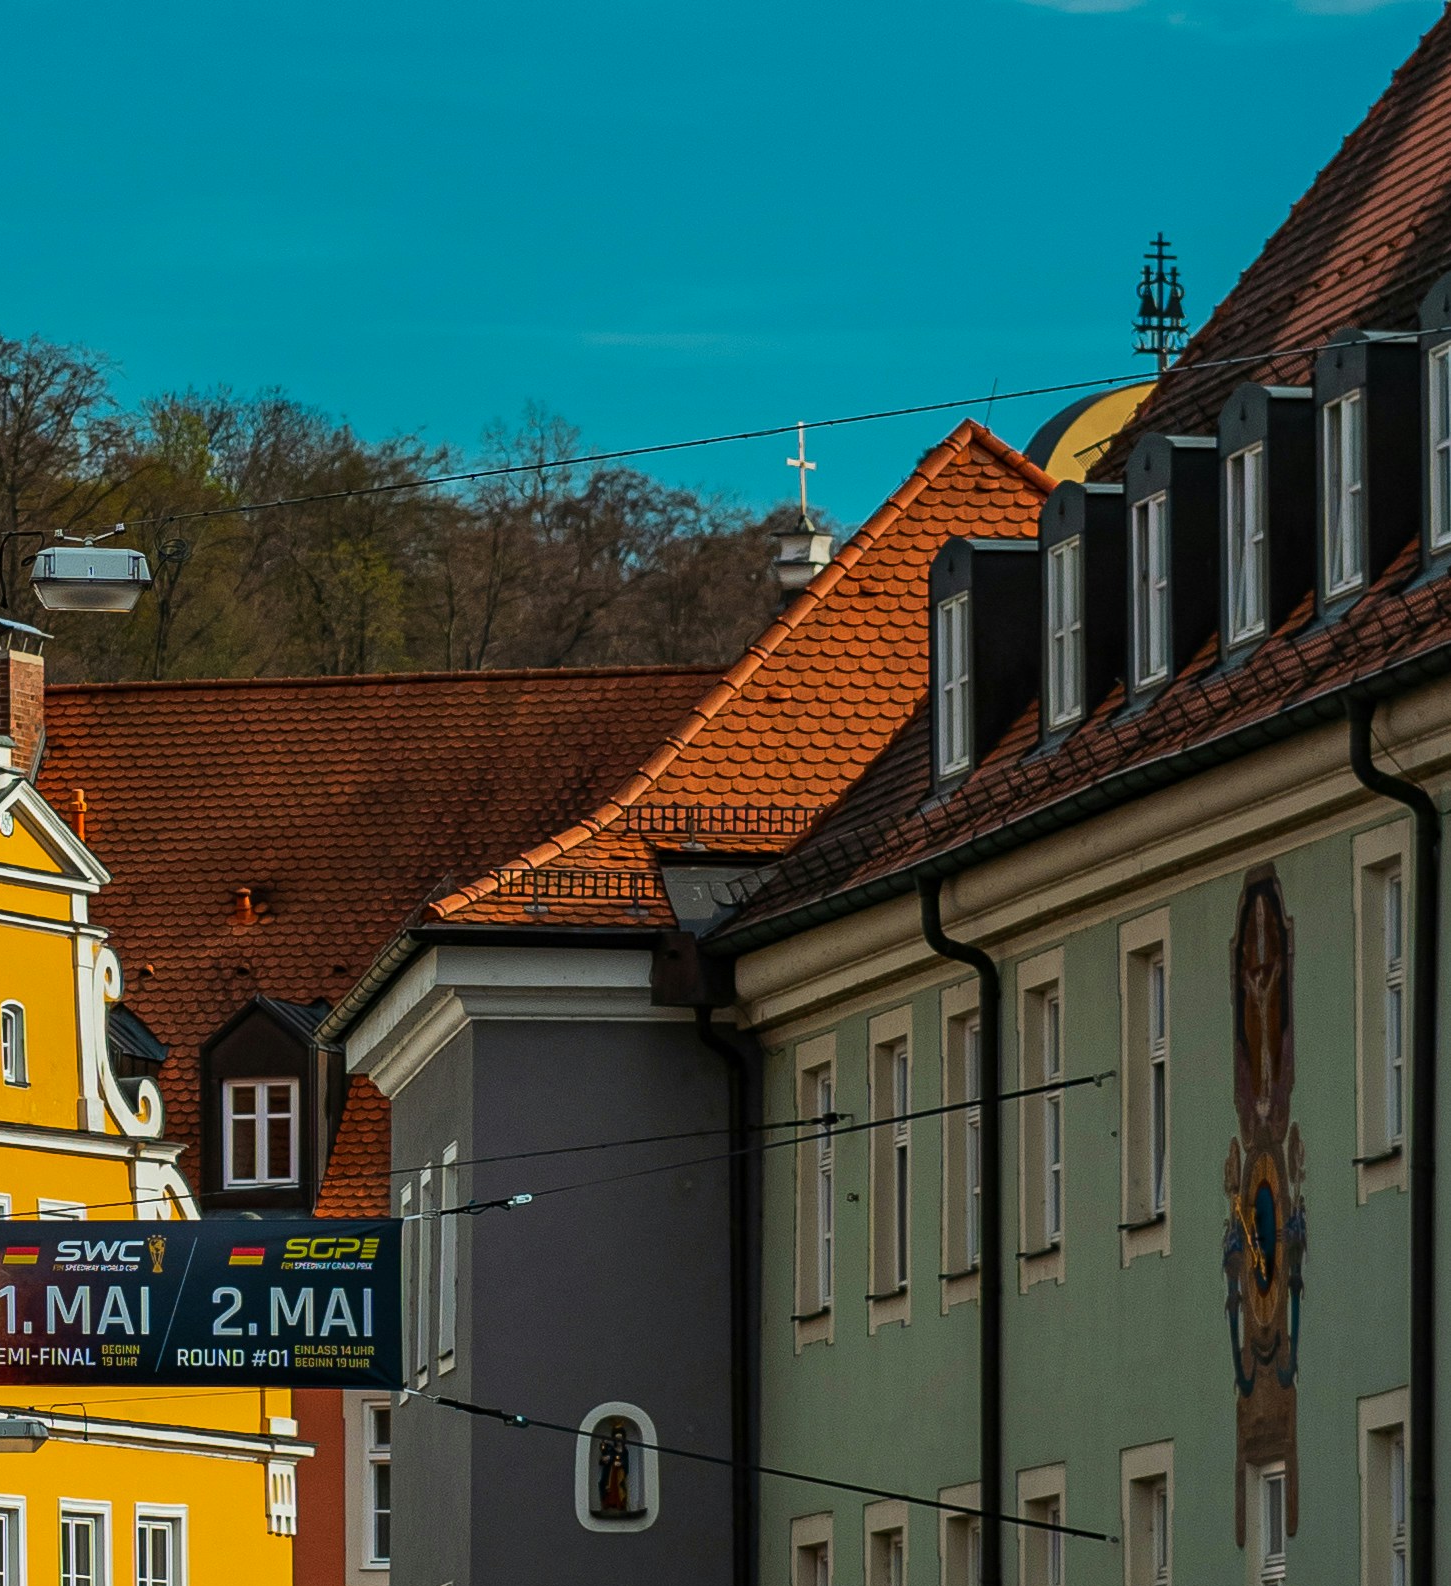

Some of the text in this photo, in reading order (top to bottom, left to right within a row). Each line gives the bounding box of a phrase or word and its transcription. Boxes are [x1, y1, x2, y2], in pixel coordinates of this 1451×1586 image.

[54, 1240, 145, 1262] SWC
[46, 1284, 151, 1336] MAI
[270, 1286, 374, 1338] MAI
[101, 1344, 141, 1356] BEGINN
[177, 1348, 289, 1368] ROUND #01
[294, 1344, 376, 1356] EINLASS 14 UHR
[101, 1356, 138, 1367] 19 UHR
[294, 1357, 371, 1369] BEGINN 19 UHR
